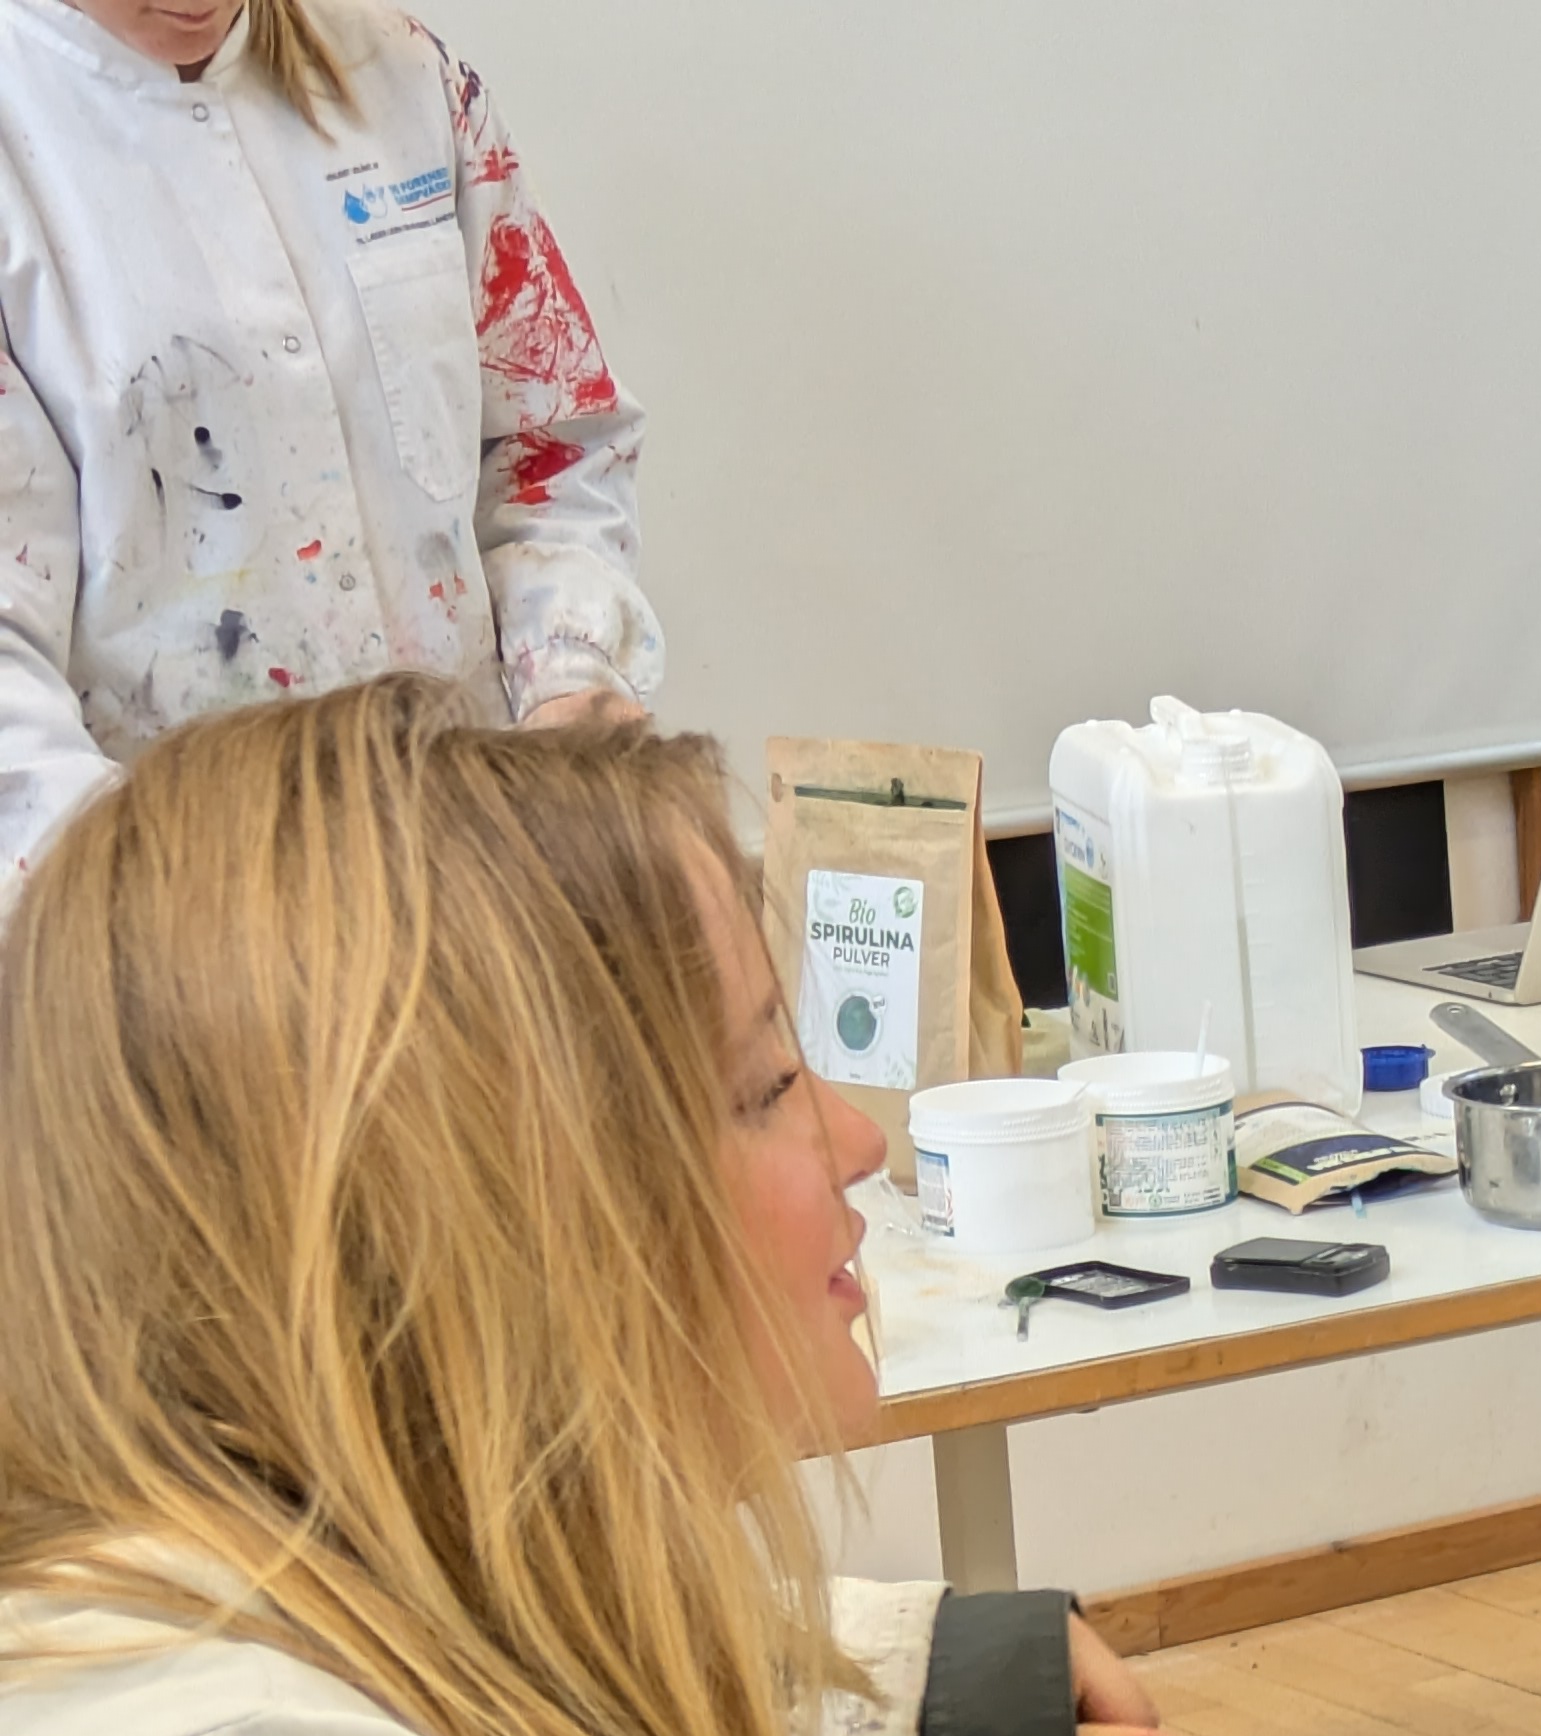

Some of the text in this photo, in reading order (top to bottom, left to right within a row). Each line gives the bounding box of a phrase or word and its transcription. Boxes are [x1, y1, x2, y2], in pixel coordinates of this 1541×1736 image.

[849, 899, 876, 924] Bio
[810, 922, 914, 952] SPIRULINA
[832, 947, 890, 967] PULVER
